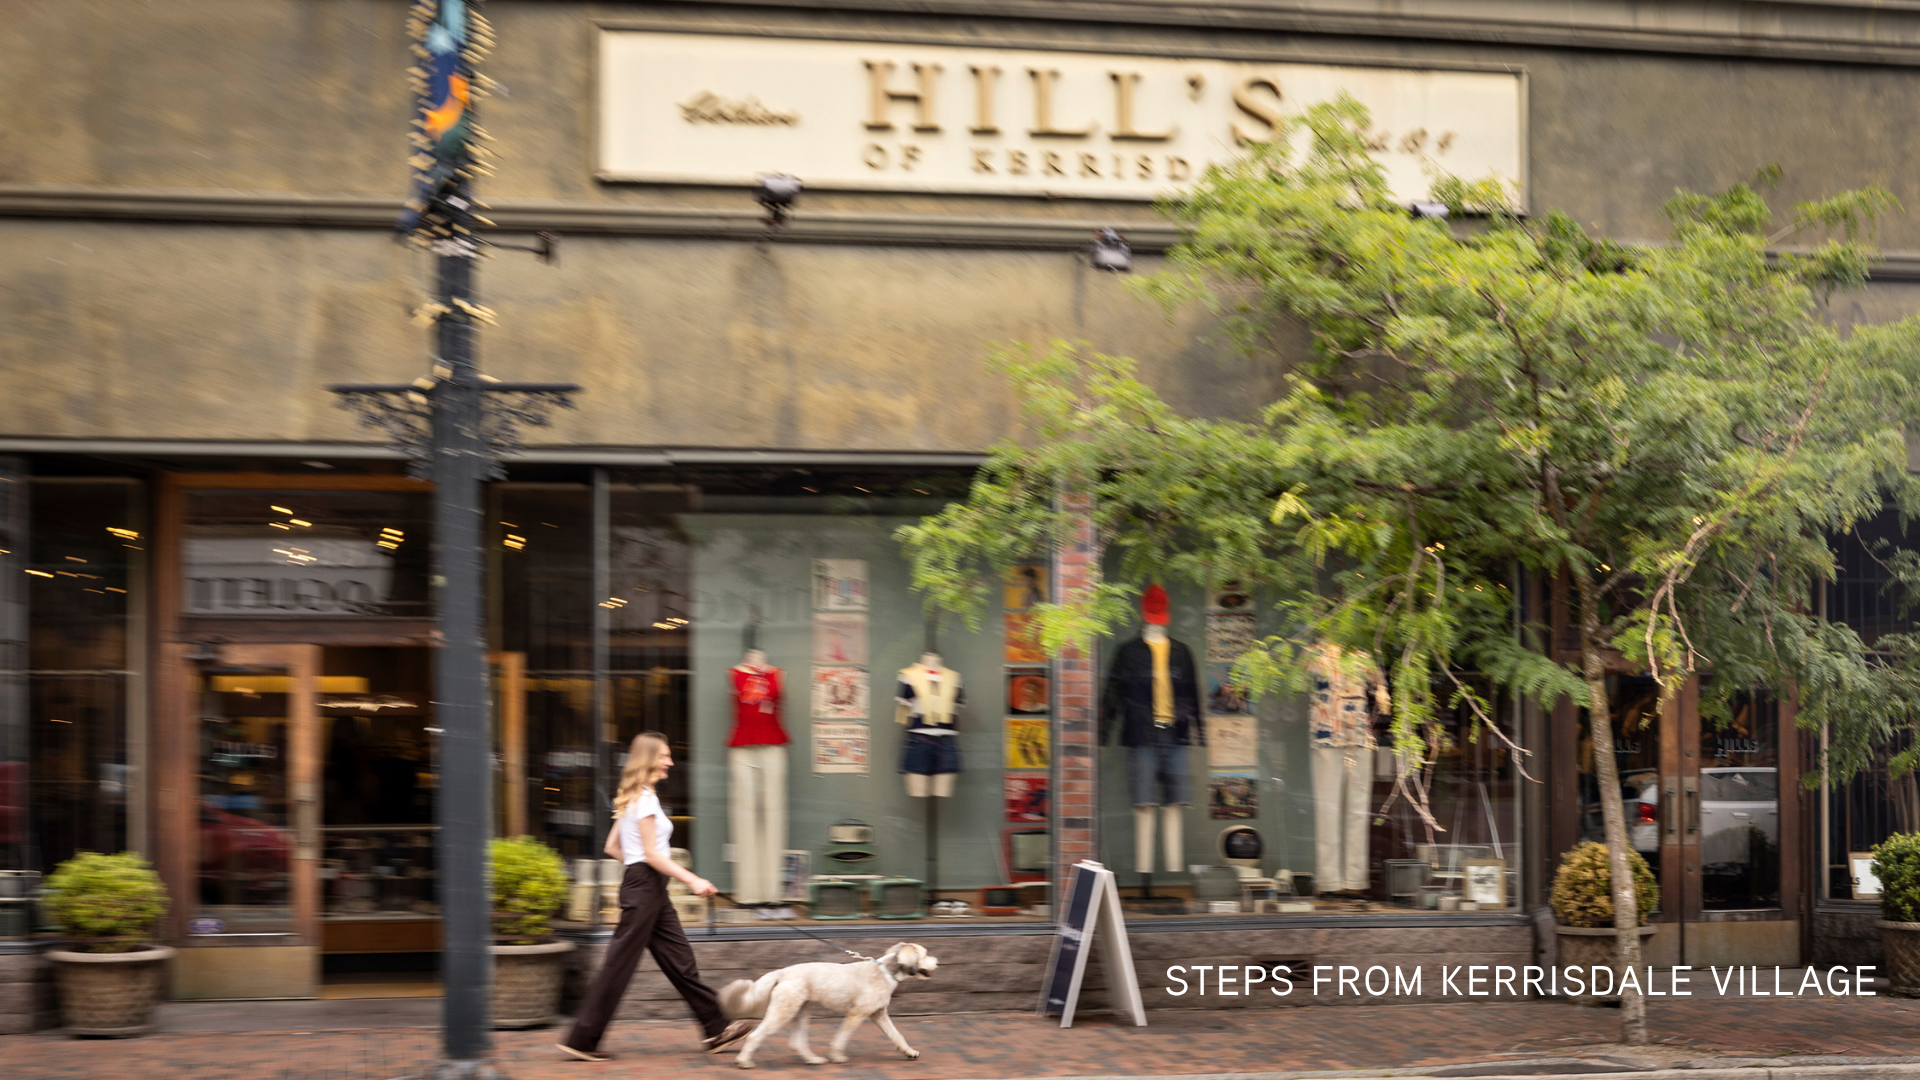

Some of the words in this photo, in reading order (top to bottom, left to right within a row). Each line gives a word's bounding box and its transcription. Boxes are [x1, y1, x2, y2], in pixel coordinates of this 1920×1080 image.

[861, 58, 1287, 149] HILL'S
[862, 142, 923, 172] OF
[969, 146, 1198, 182] KERRISD
